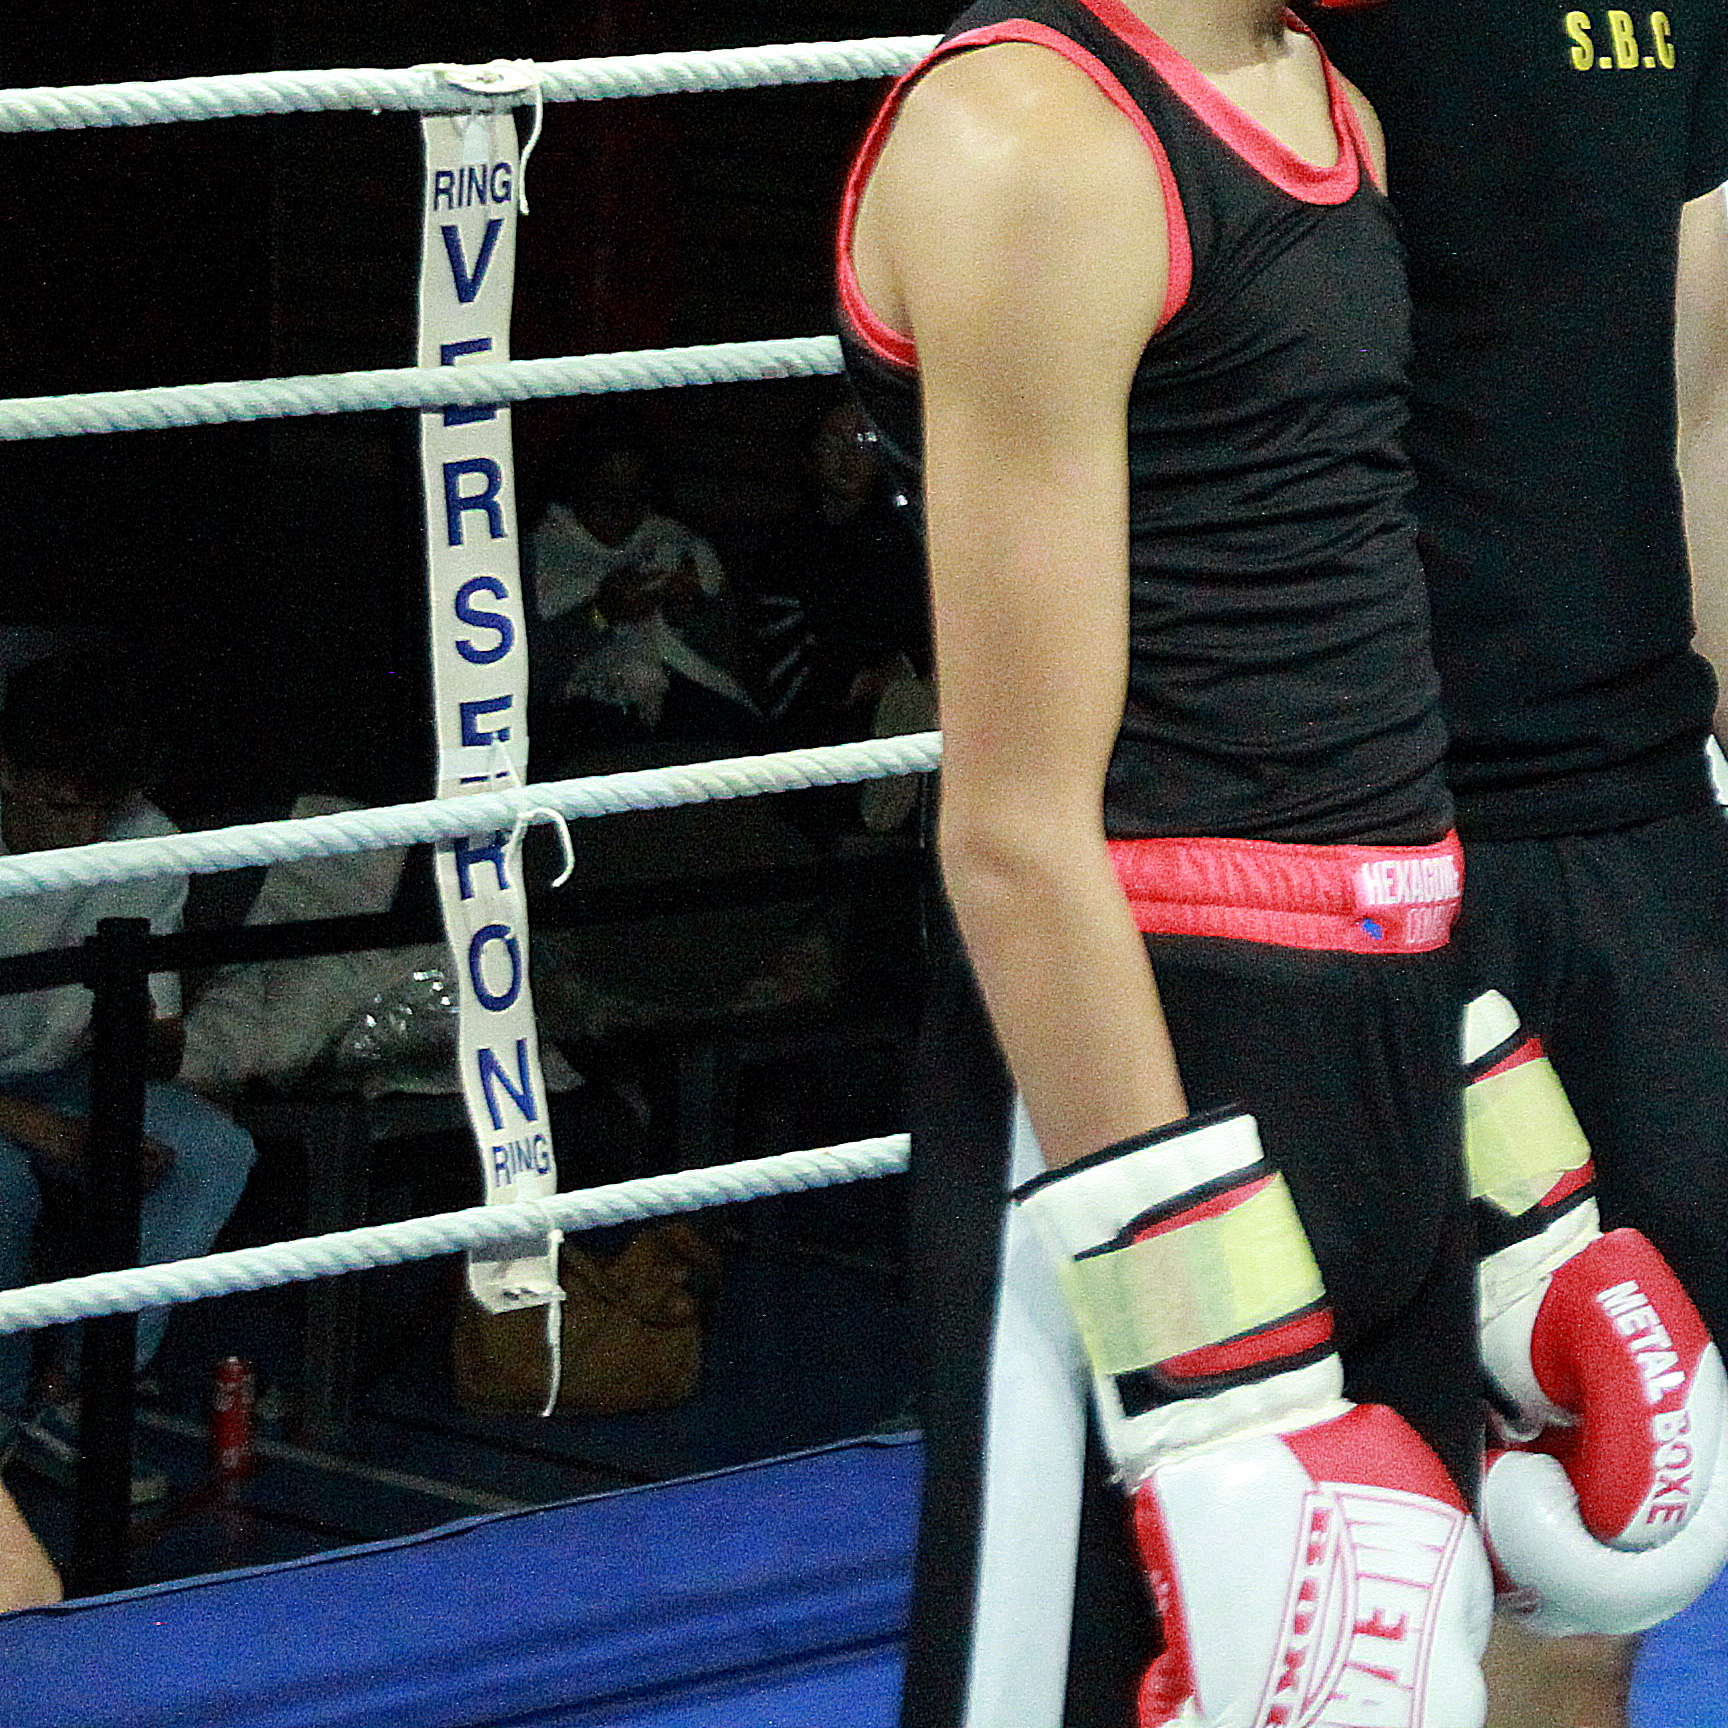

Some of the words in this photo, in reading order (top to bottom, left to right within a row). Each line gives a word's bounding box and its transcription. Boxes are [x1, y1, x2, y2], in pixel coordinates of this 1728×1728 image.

[433, 161, 513, 211] RING
[492, 1133, 551, 1188] RING
[1597, 1279, 1687, 1405] METAL
[1645, 1406, 1695, 1525] BOXE
[1312, 1490, 1462, 1728] META
